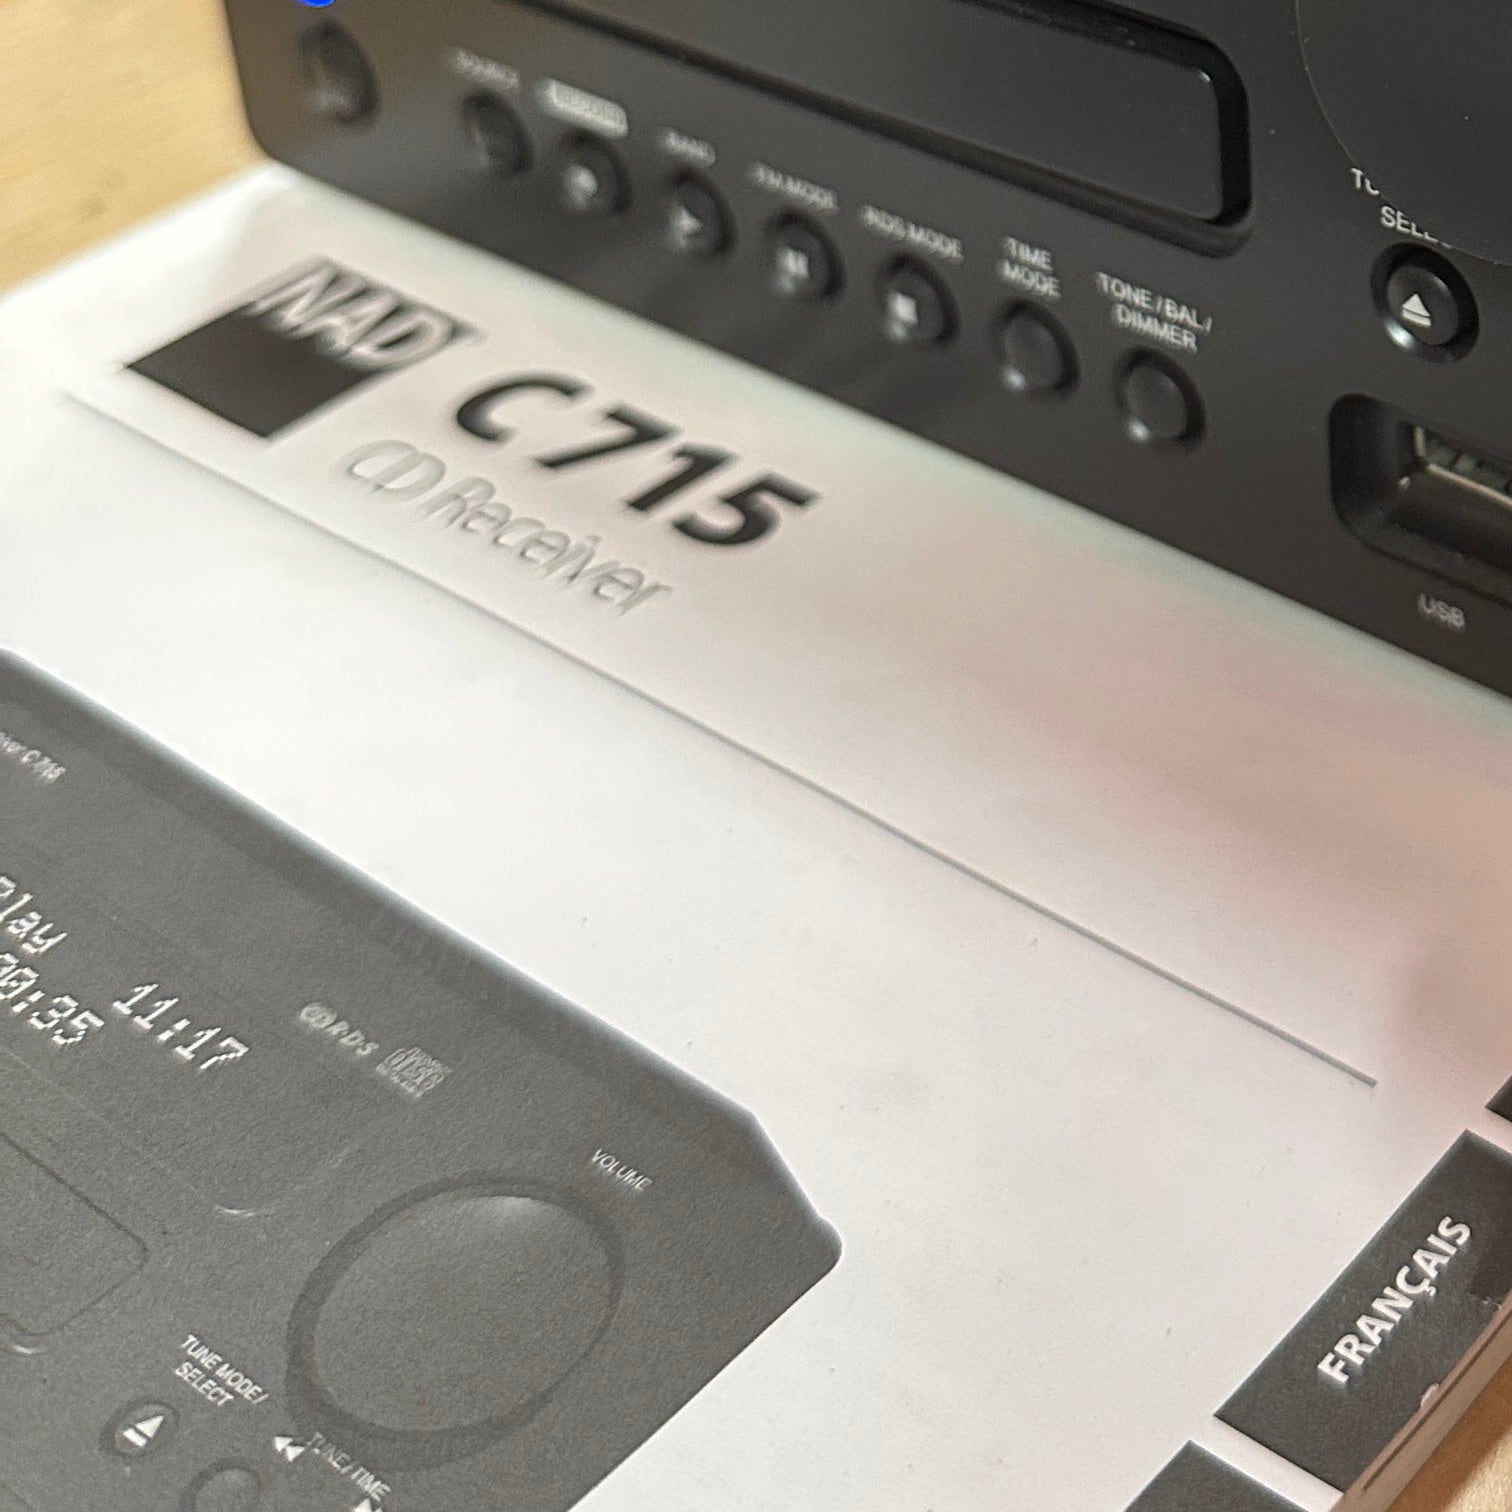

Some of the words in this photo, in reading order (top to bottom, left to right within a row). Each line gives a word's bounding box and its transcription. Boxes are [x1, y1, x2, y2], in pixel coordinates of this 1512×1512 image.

[906, 221, 965, 262] MODE
[1003, 235, 1053, 272] TIME
[1001, 259, 1061, 299] MODE
[256, 260, 464, 370] NAD
[1113, 304, 1198, 354] DIMMER
[455, 369, 596, 444] C
[536, 402, 823, 548] 715
[426, 475, 669, 616] Receiver
[1417, 593, 1467, 630] USB
[111, 982, 250, 1071] 11:17
[591, 1148, 654, 1193] VOLUME
[1316, 1216, 1473, 1383] FRANÇAIS
[181, 1334, 223, 1370] TUNE
[174, 1361, 235, 1407] SELECT
